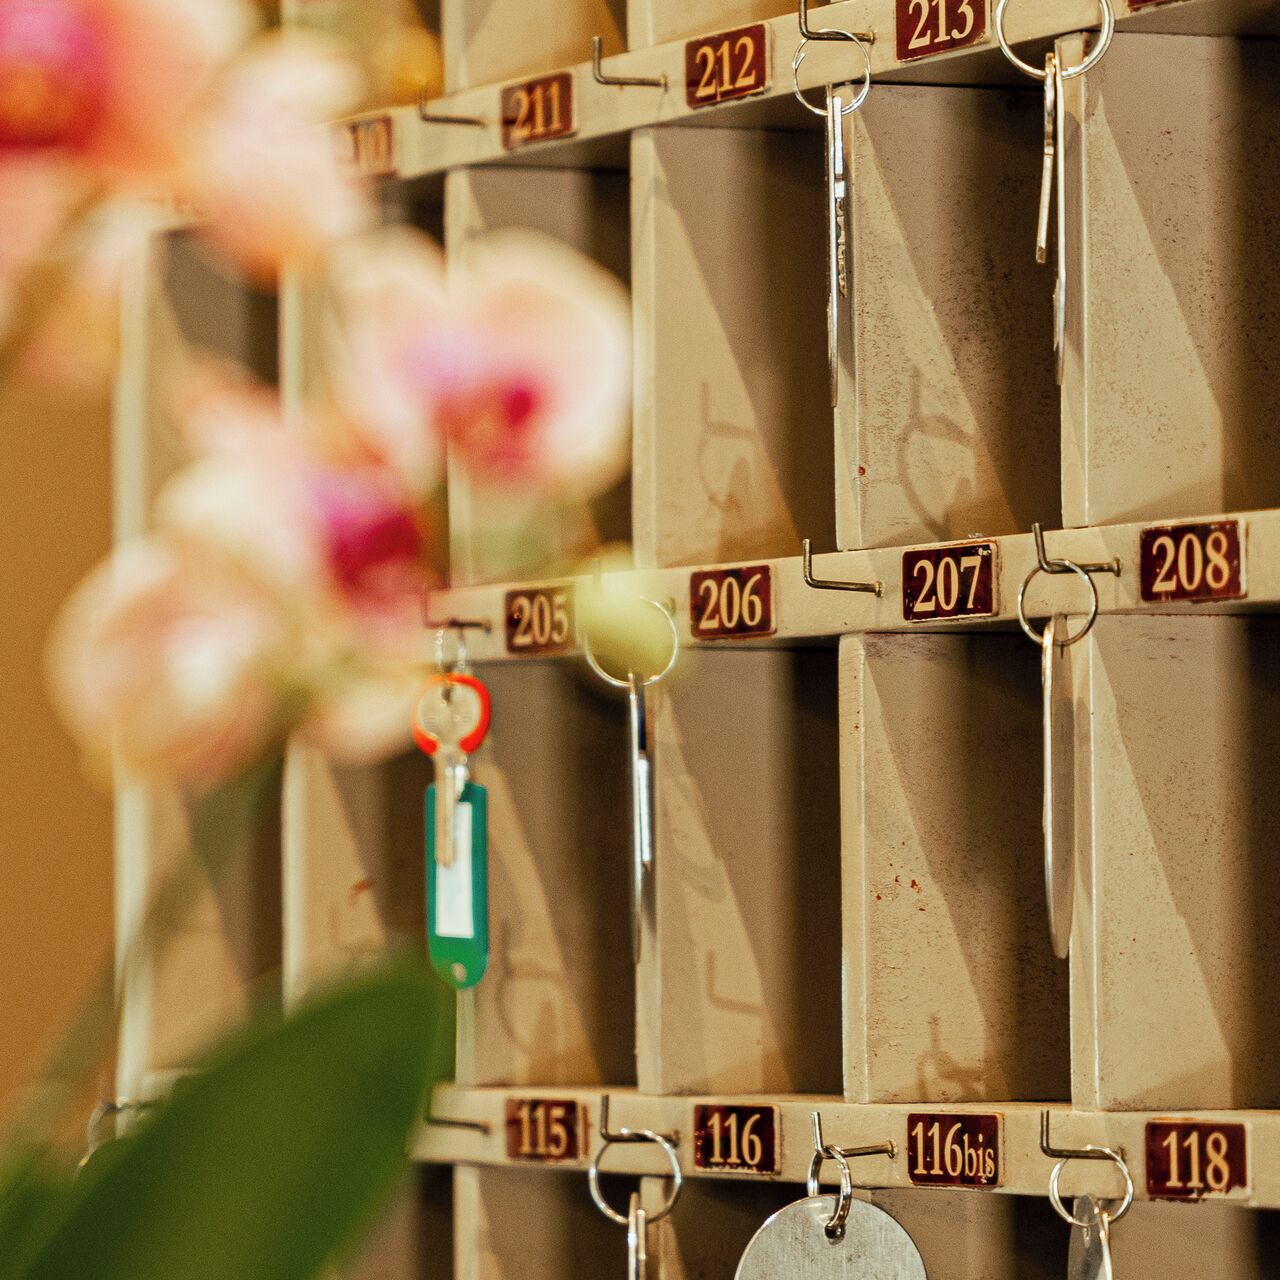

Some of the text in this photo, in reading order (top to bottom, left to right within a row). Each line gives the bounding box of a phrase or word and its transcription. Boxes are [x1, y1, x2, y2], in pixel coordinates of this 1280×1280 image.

[694, 35, 756, 99] 212
[509, 80, 562, 142] 211
[913, 556, 982, 612] 207
[1152, 536, 1230, 591] 208
[512, 594, 568, 647] 205
[699, 577, 762, 630] 206
[516, 1100, 568, 1156] 115
[708, 1110, 762, 1167] 116
[911, 1118, 996, 1182] 116bis
[1162, 1133, 1228, 1193] 118
